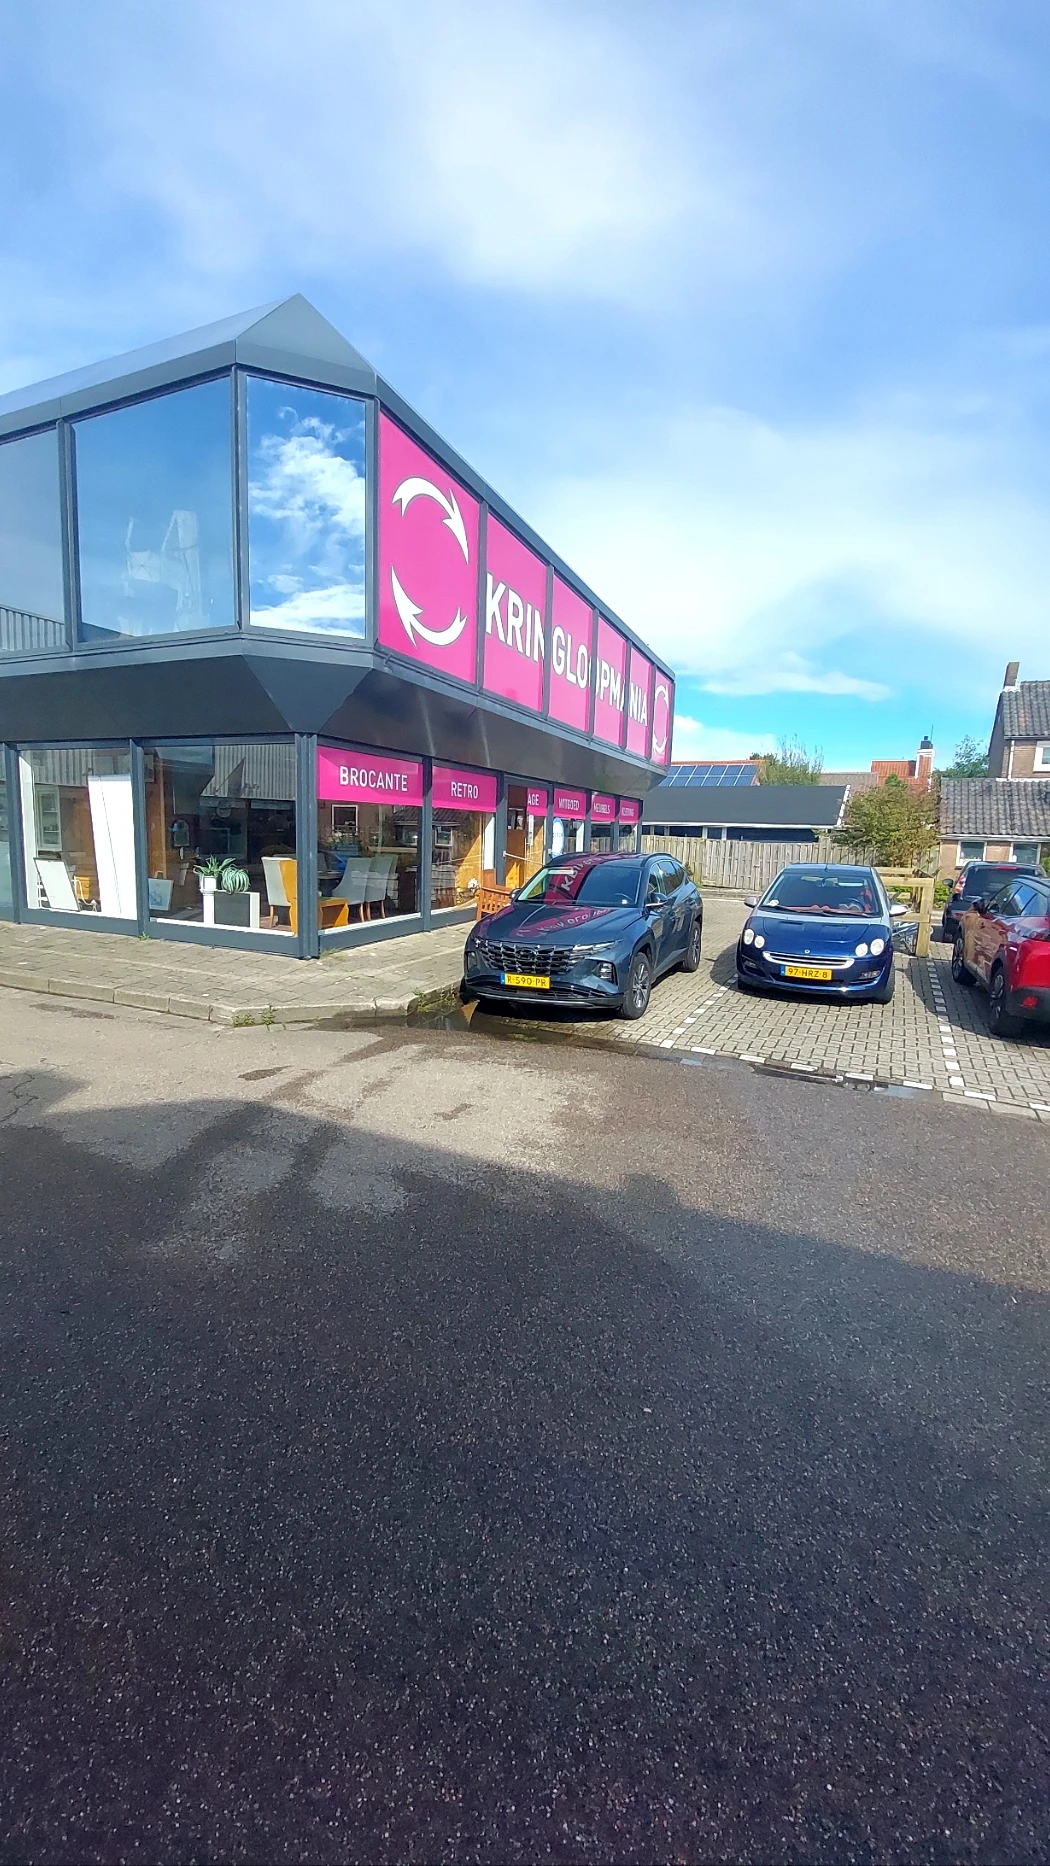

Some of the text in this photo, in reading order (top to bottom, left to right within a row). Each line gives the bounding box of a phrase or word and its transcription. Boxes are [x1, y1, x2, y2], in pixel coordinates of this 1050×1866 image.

[339, 766, 408, 792] BROCANTE
[451, 781, 479, 799] RETRO
[788, 968, 828, 979] 97-HRZ-8
